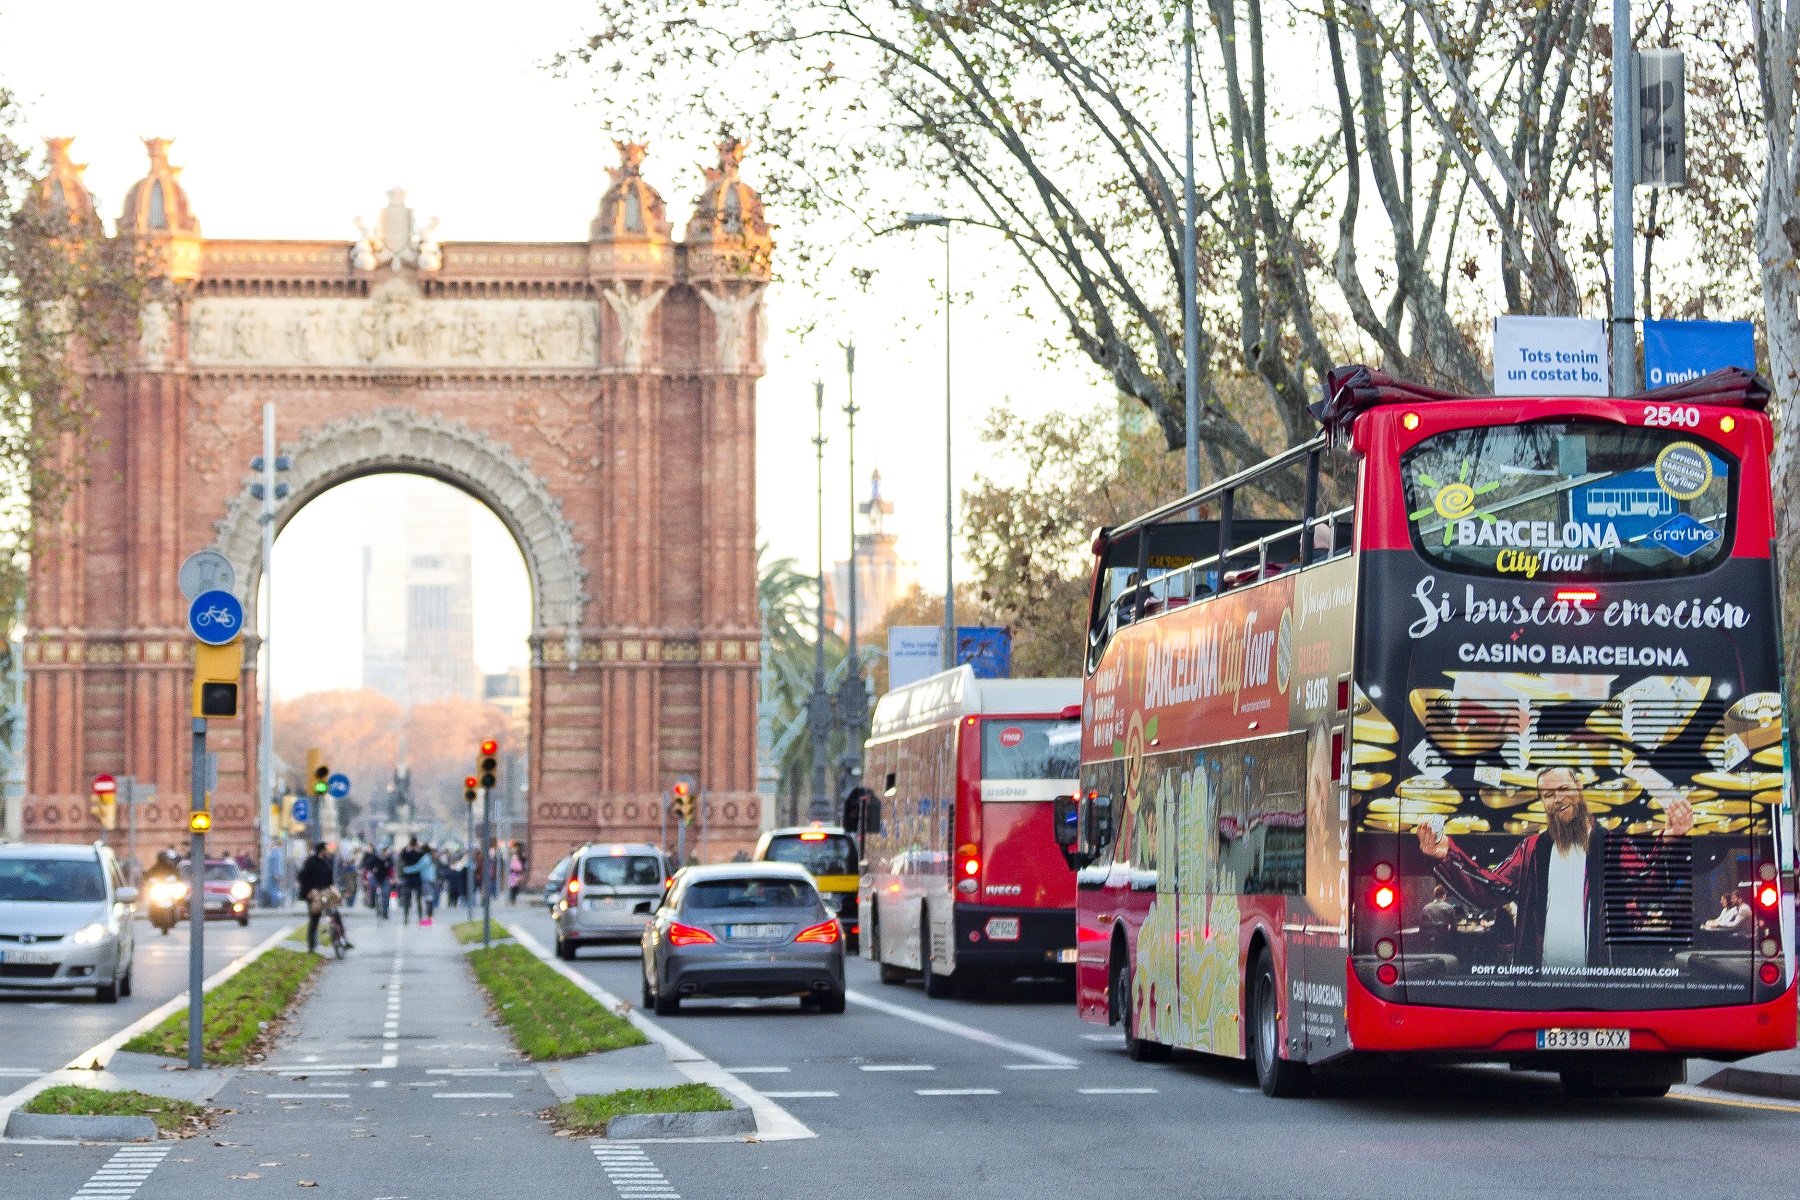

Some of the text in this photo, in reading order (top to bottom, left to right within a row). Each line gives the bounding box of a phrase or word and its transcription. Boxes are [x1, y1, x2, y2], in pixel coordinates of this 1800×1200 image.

[1519, 348, 1599, 364] Tots tenim
[1507, 367, 1602, 383] un costat bo.
[1650, 367, 1662, 384] O
[1643, 405, 1700, 427] 2540
[1661, 460, 1705, 481] BARCELONA
[1458, 520, 1622, 548] BARCELONA
[1408, 575, 1751, 640] Si buscas emoción
[1144, 621, 1218, 710] BARCELONA
[1458, 643, 1690, 667] CASINO BARCELONA
[1305, 676, 1329, 710] SLOTS
[1471, 965, 1496, 975] PORT
[1541, 965, 1680, 977] WWW.CASINOBARCELONA.COM
[1548, 1031, 1625, 1047] 8339 GXX
